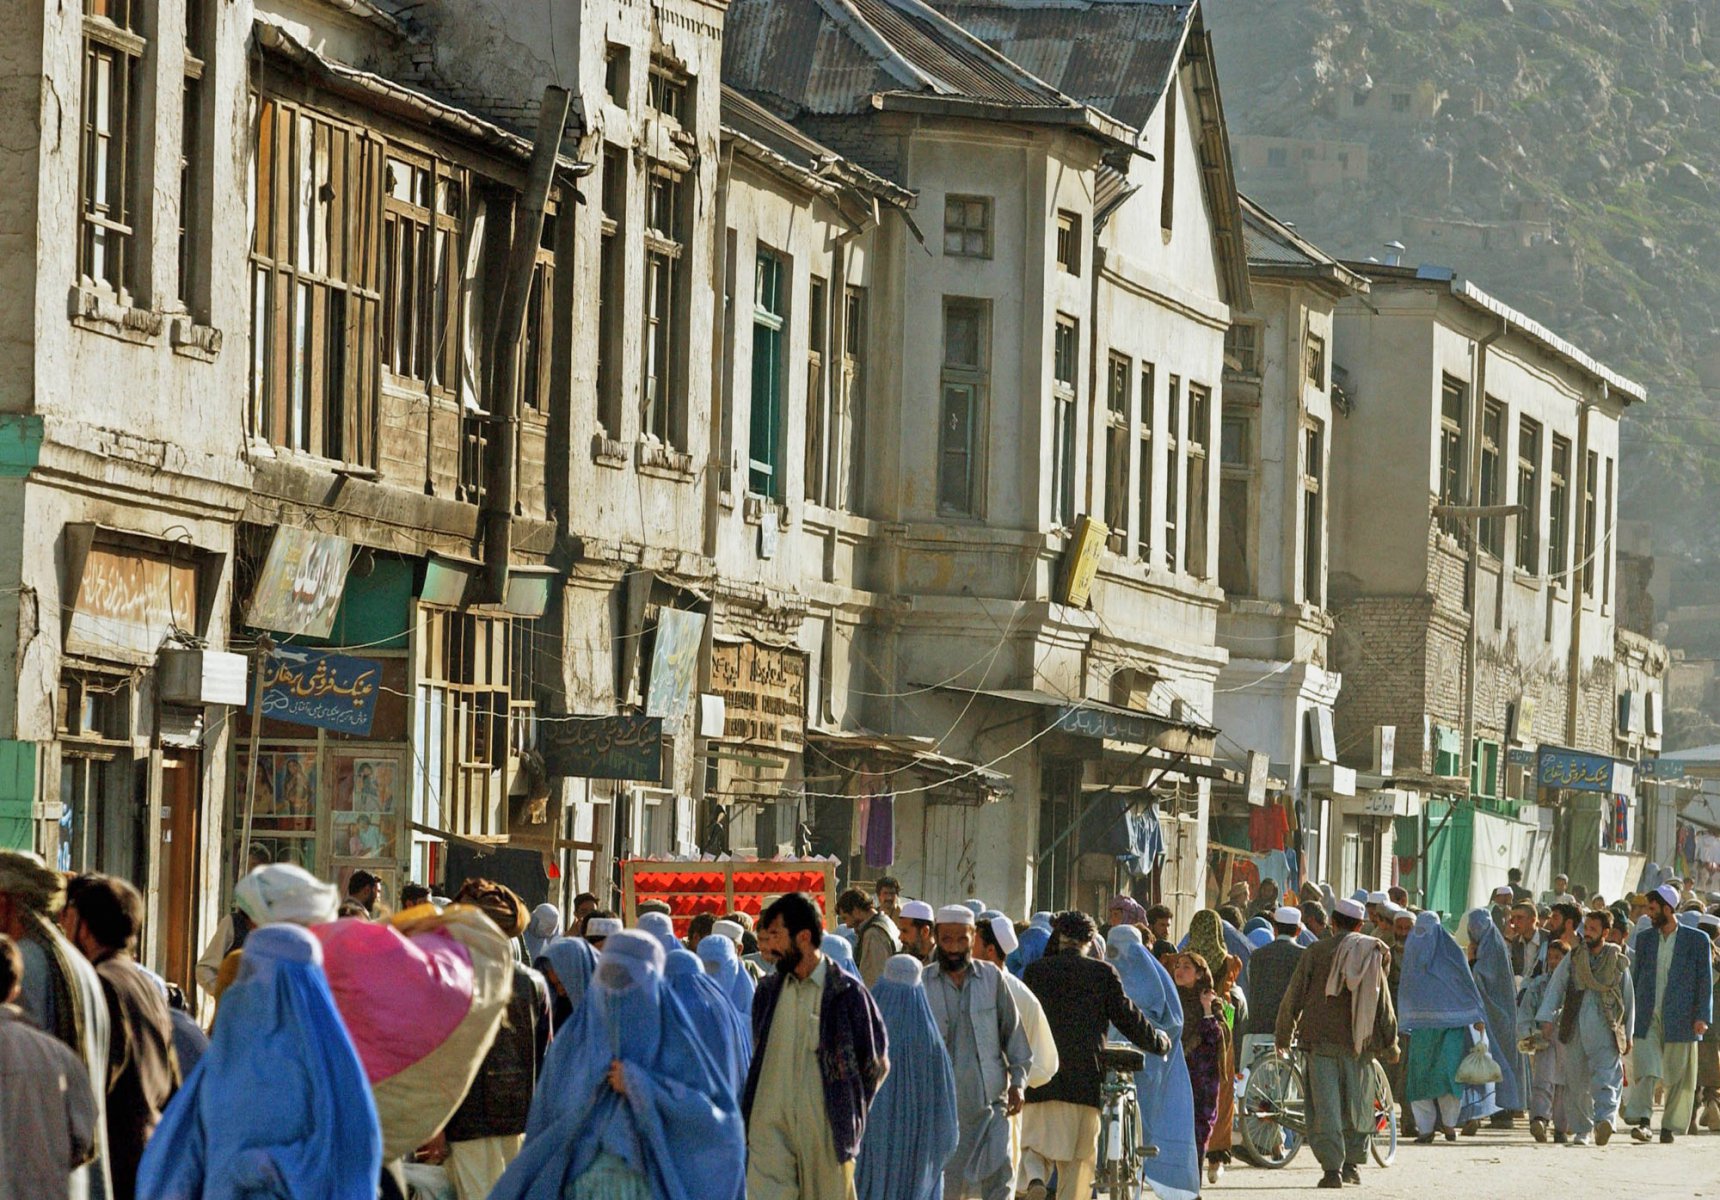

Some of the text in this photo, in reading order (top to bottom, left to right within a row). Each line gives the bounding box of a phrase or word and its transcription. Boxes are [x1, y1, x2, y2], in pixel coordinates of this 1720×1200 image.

[296, 659, 338, 696] فروشی
[333, 669, 376, 706] عینک
[1562, 759, 1587, 784] فروشی
[1365, 796, 1393, 812] دواخانه
